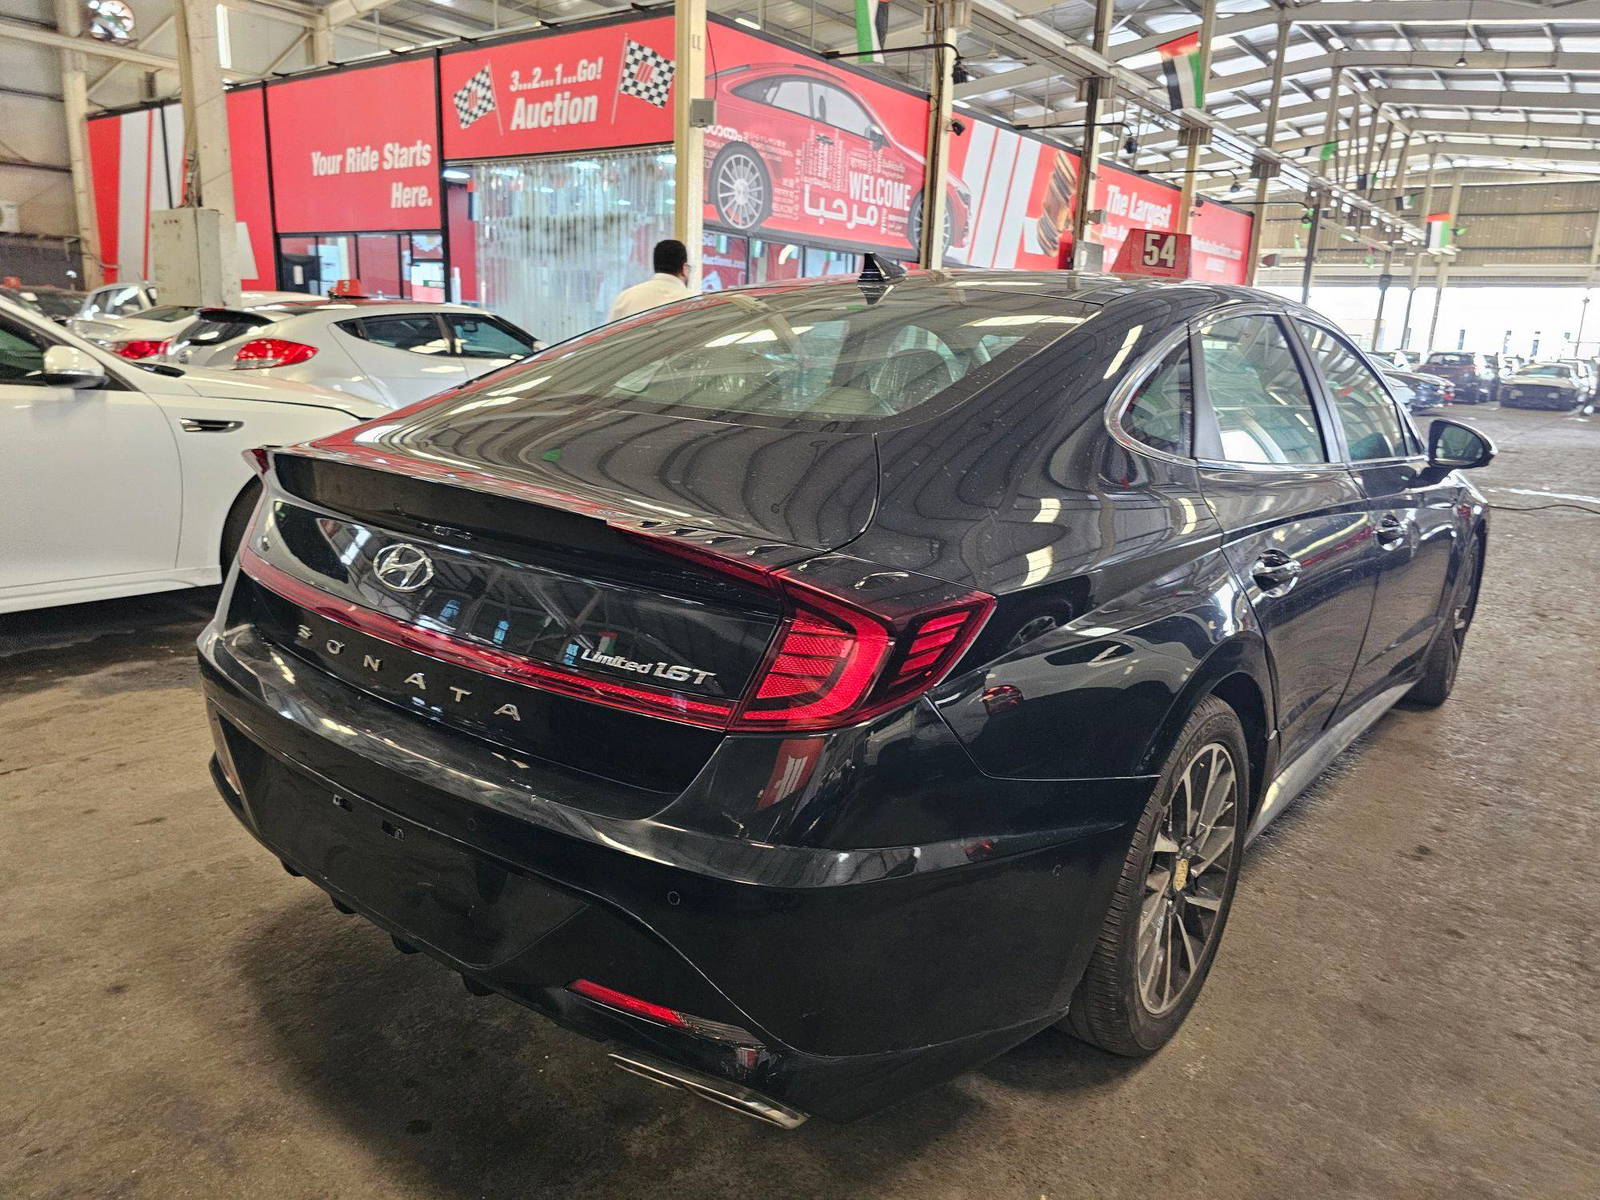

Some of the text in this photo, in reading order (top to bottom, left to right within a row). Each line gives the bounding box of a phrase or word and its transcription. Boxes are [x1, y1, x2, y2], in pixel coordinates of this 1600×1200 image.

[509, 57, 604, 93] 3...2...1...Go!
[509, 91, 599, 131] Auction
[310, 139, 433, 177] Your Ride Starts
[390, 181, 433, 209] Here.
[803, 183, 879, 230] مرحبا
[848, 171, 913, 211] WELCOME
[1107, 184, 1172, 230] The Largest
[1143, 232, 1176, 268] 54
[297, 624, 522, 722] SONATA
[580, 649, 654, 675] Limited
